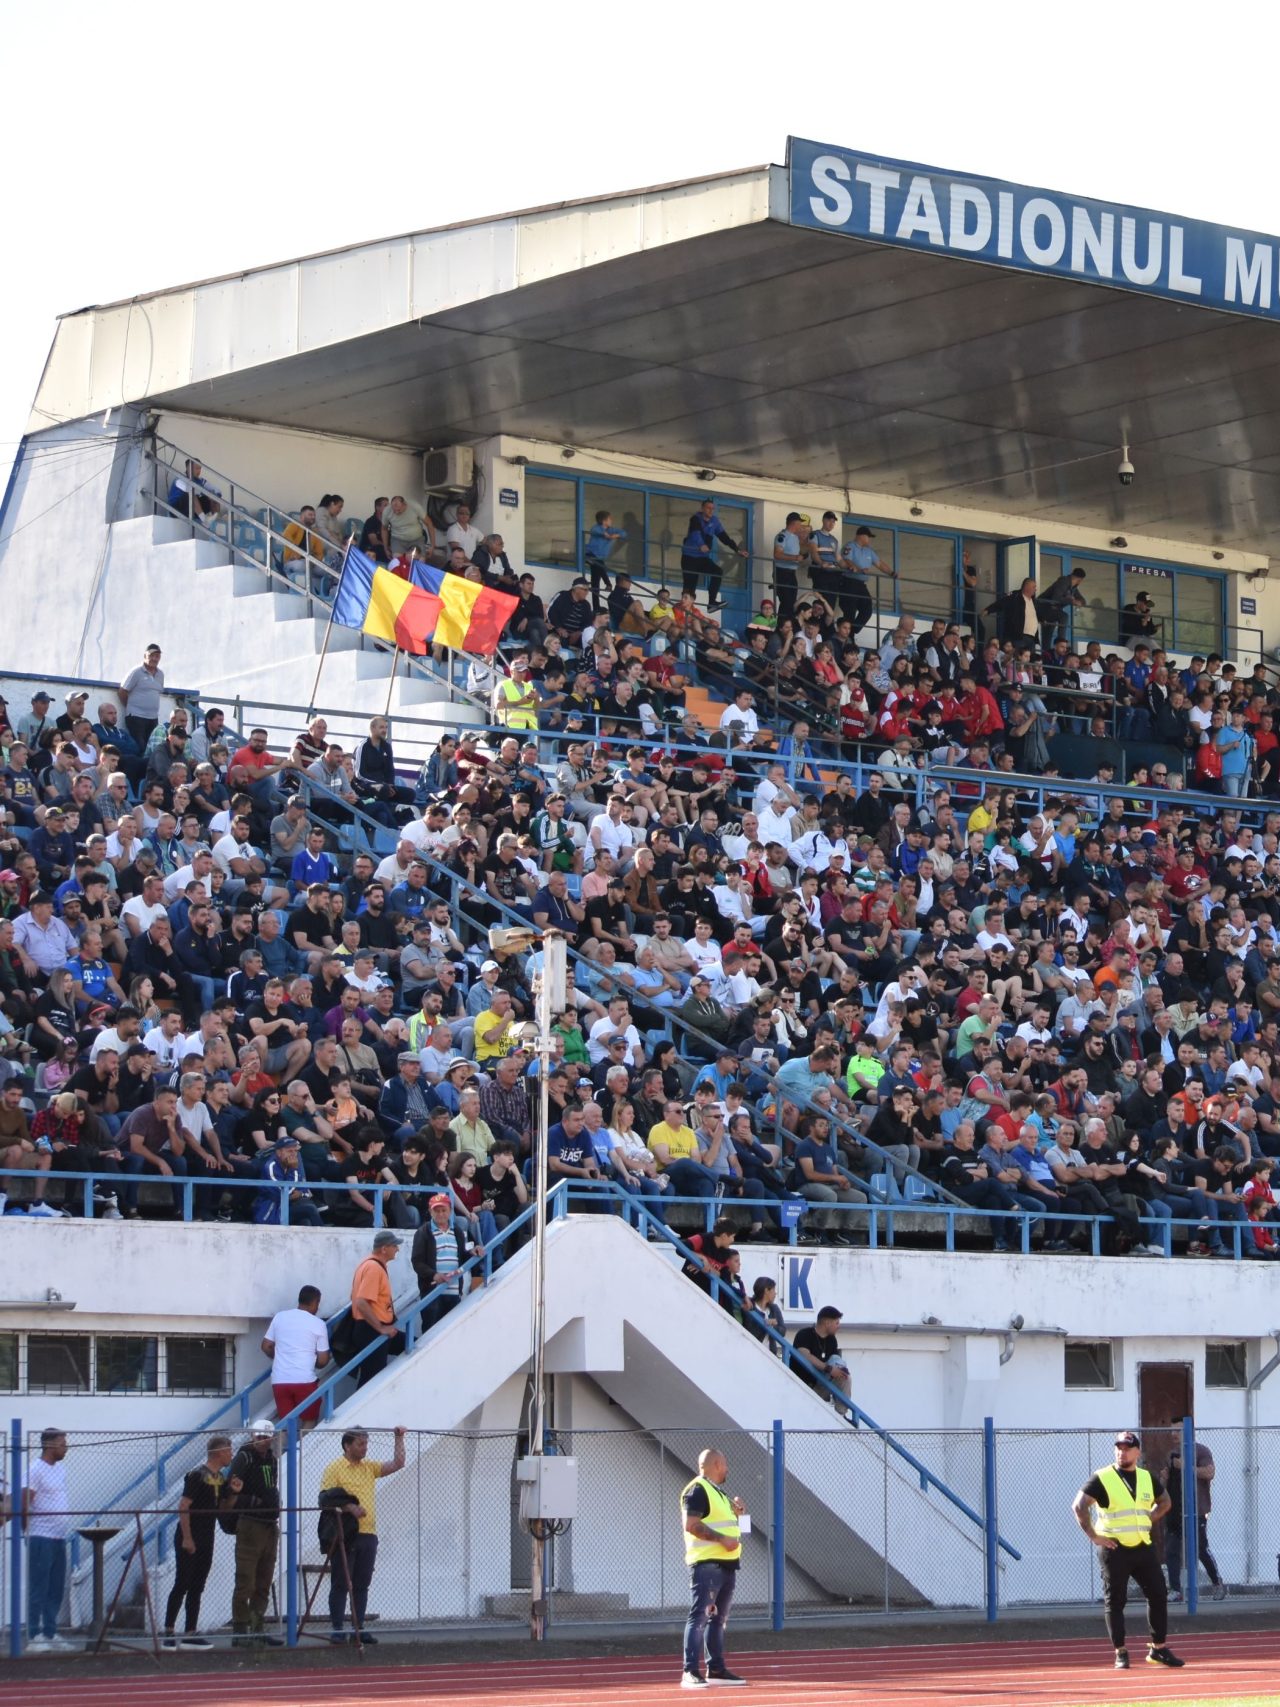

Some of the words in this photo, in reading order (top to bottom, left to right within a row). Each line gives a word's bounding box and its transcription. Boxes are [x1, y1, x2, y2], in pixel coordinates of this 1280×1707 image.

[809, 155, 1201, 295] STADIONUL
[1131, 565, 1166, 577] PRESA
[789, 1257, 814, 1309] K
